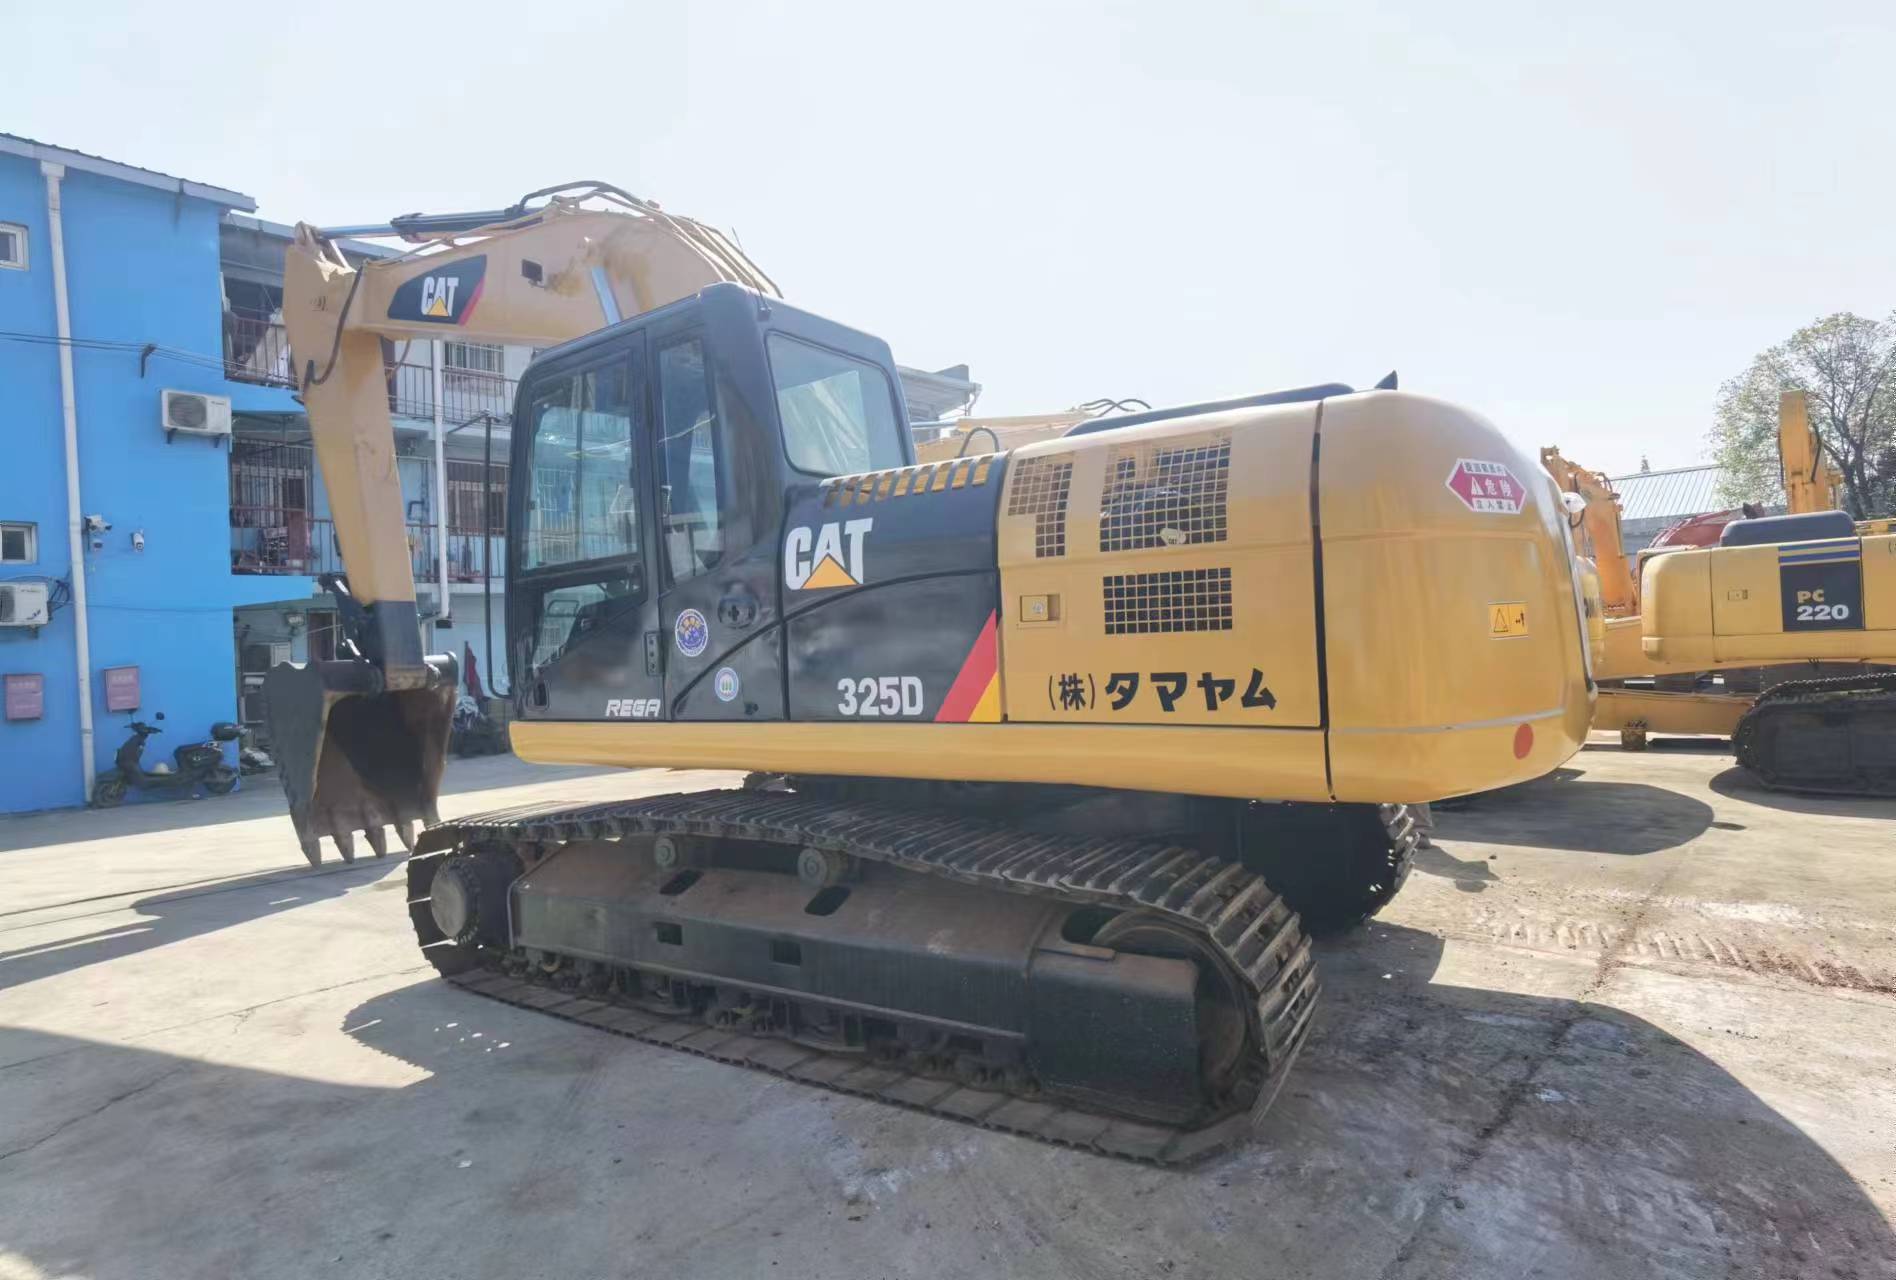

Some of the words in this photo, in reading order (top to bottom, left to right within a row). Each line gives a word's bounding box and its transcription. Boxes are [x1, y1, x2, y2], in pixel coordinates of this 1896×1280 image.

[421, 276, 460, 317] CAT
[784, 517, 873, 591] CAT
[1797, 589, 1825, 603] PC
[1797, 604, 1850, 621] 220
[605, 699, 661, 717] REGA
[837, 676, 924, 716] 325D
